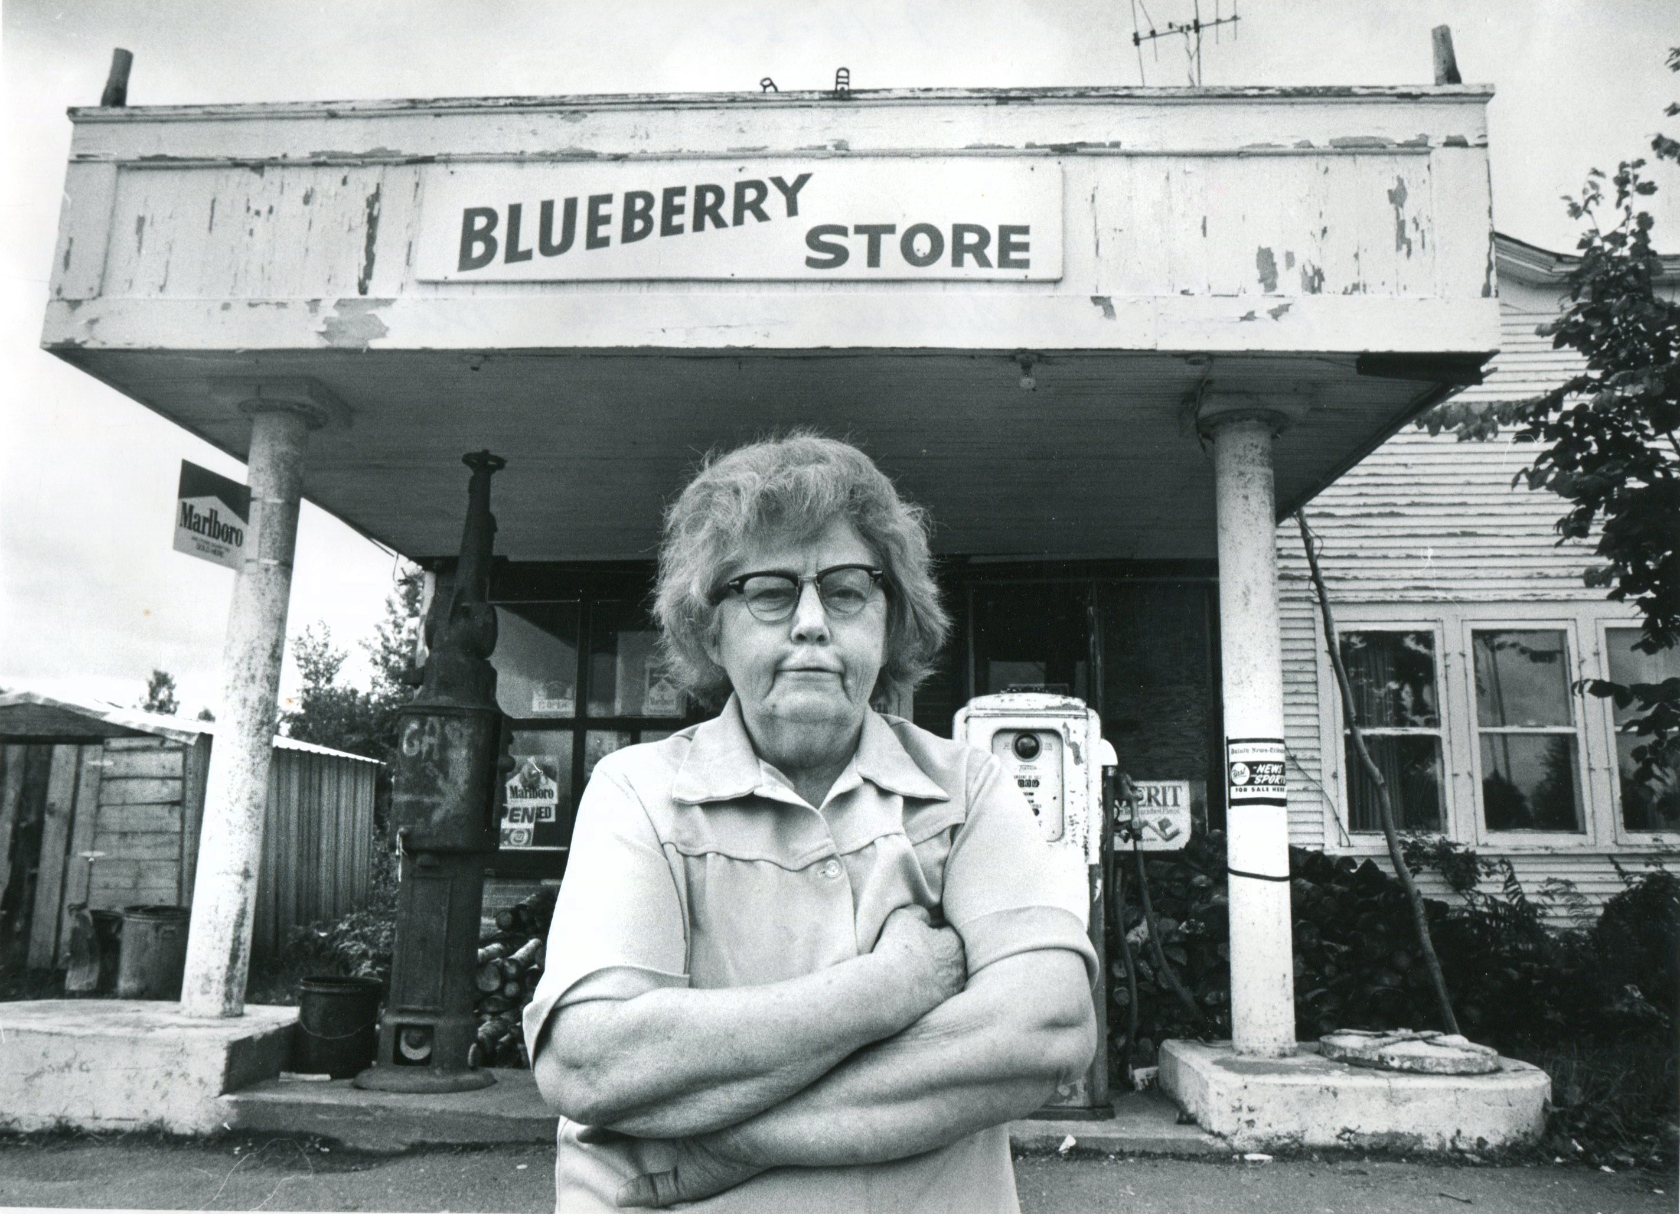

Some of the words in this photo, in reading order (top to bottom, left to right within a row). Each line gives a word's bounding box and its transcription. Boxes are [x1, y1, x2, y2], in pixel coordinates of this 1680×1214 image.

[457, 172, 813, 272] BLUEBERRY
[804, 223, 1031, 270] STORE
[179, 501, 244, 548] Marlboro
[509, 785, 554, 799] Marlboro
[1116, 786, 1183, 807] ERIT
[508, 806, 536, 824] EN
[536, 806, 552, 819] ED
